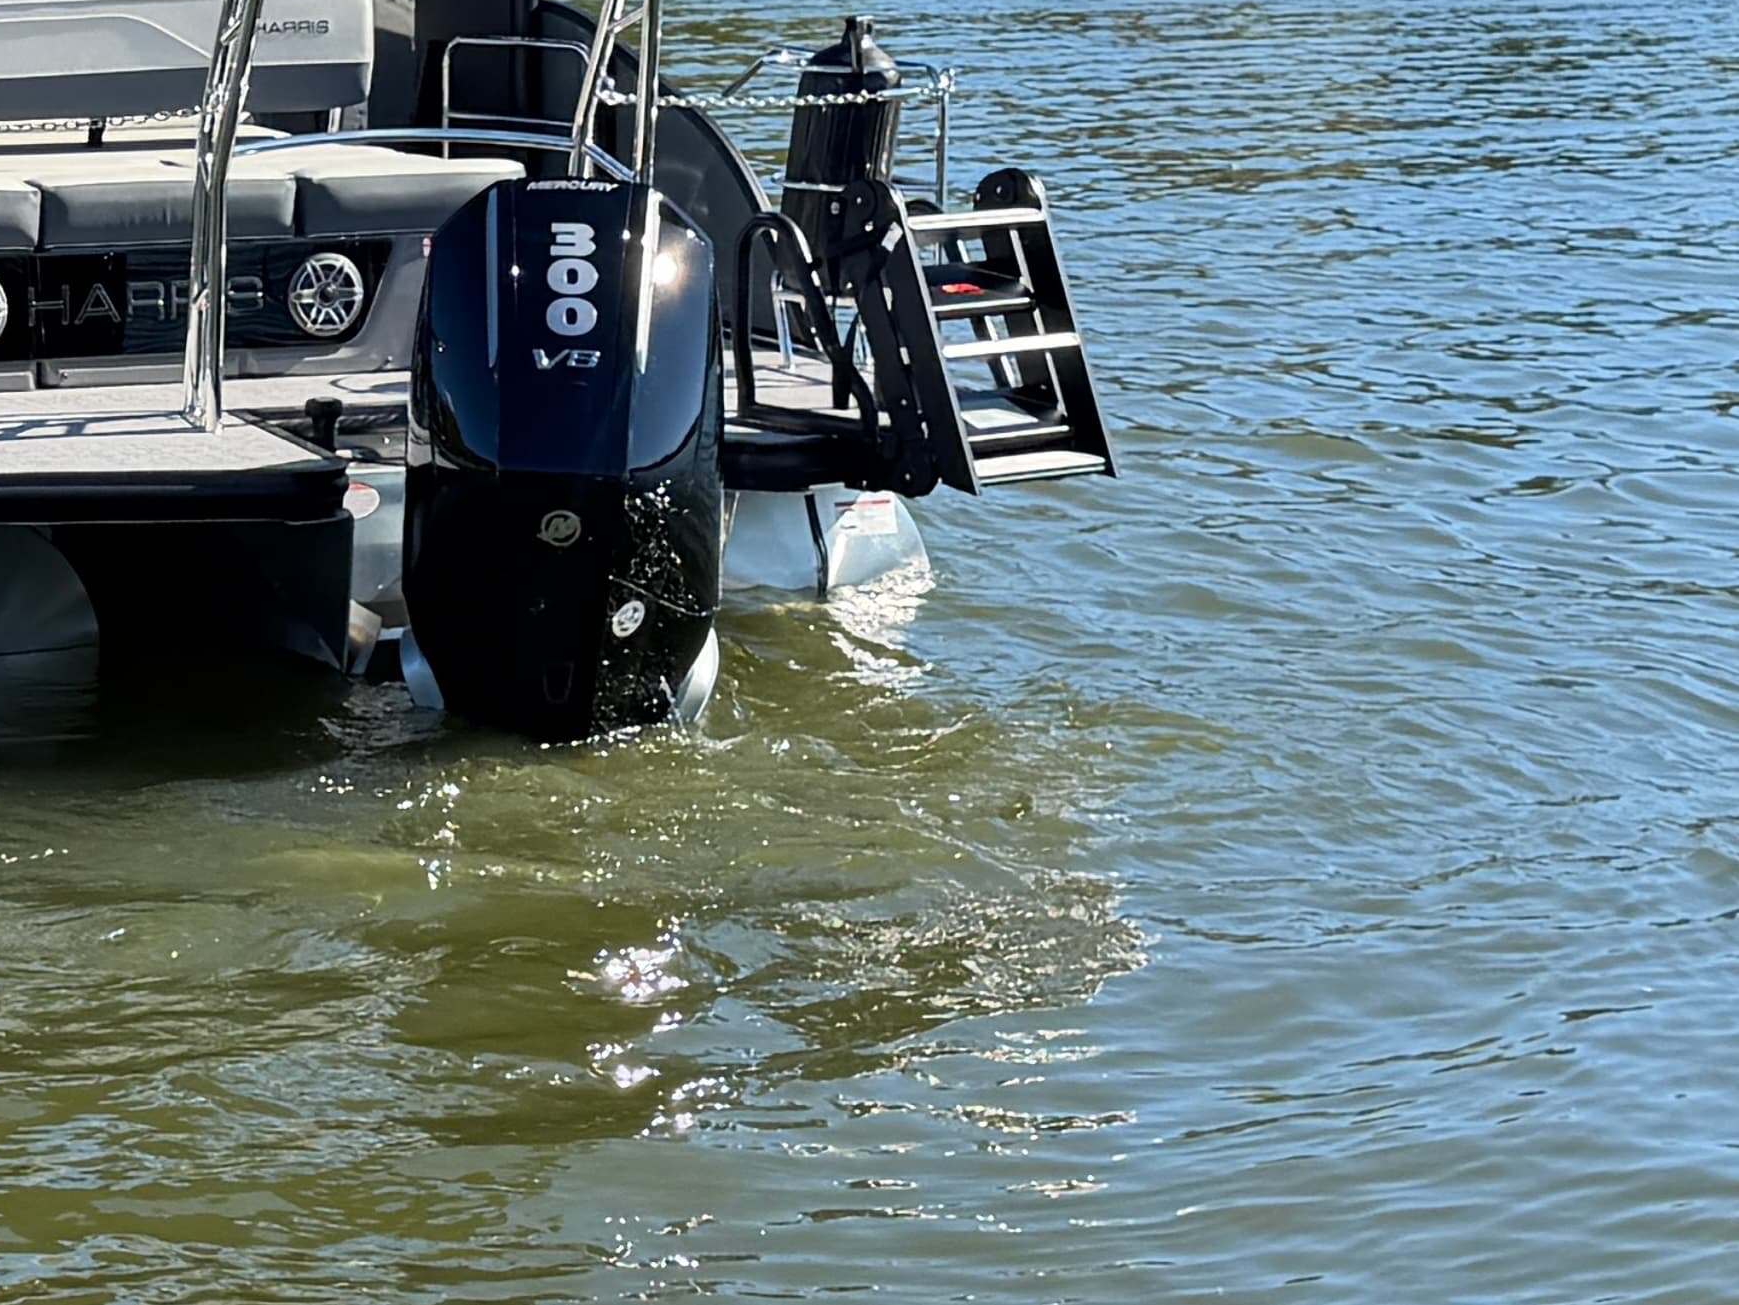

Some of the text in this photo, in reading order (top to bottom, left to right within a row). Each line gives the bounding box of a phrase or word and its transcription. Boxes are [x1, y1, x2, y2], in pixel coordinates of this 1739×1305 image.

[255, 19, 329, 35] HARRIS
[526, 180, 620, 192] MERCURY
[545, 222, 600, 336] 300
[532, 348, 601, 369] V8
